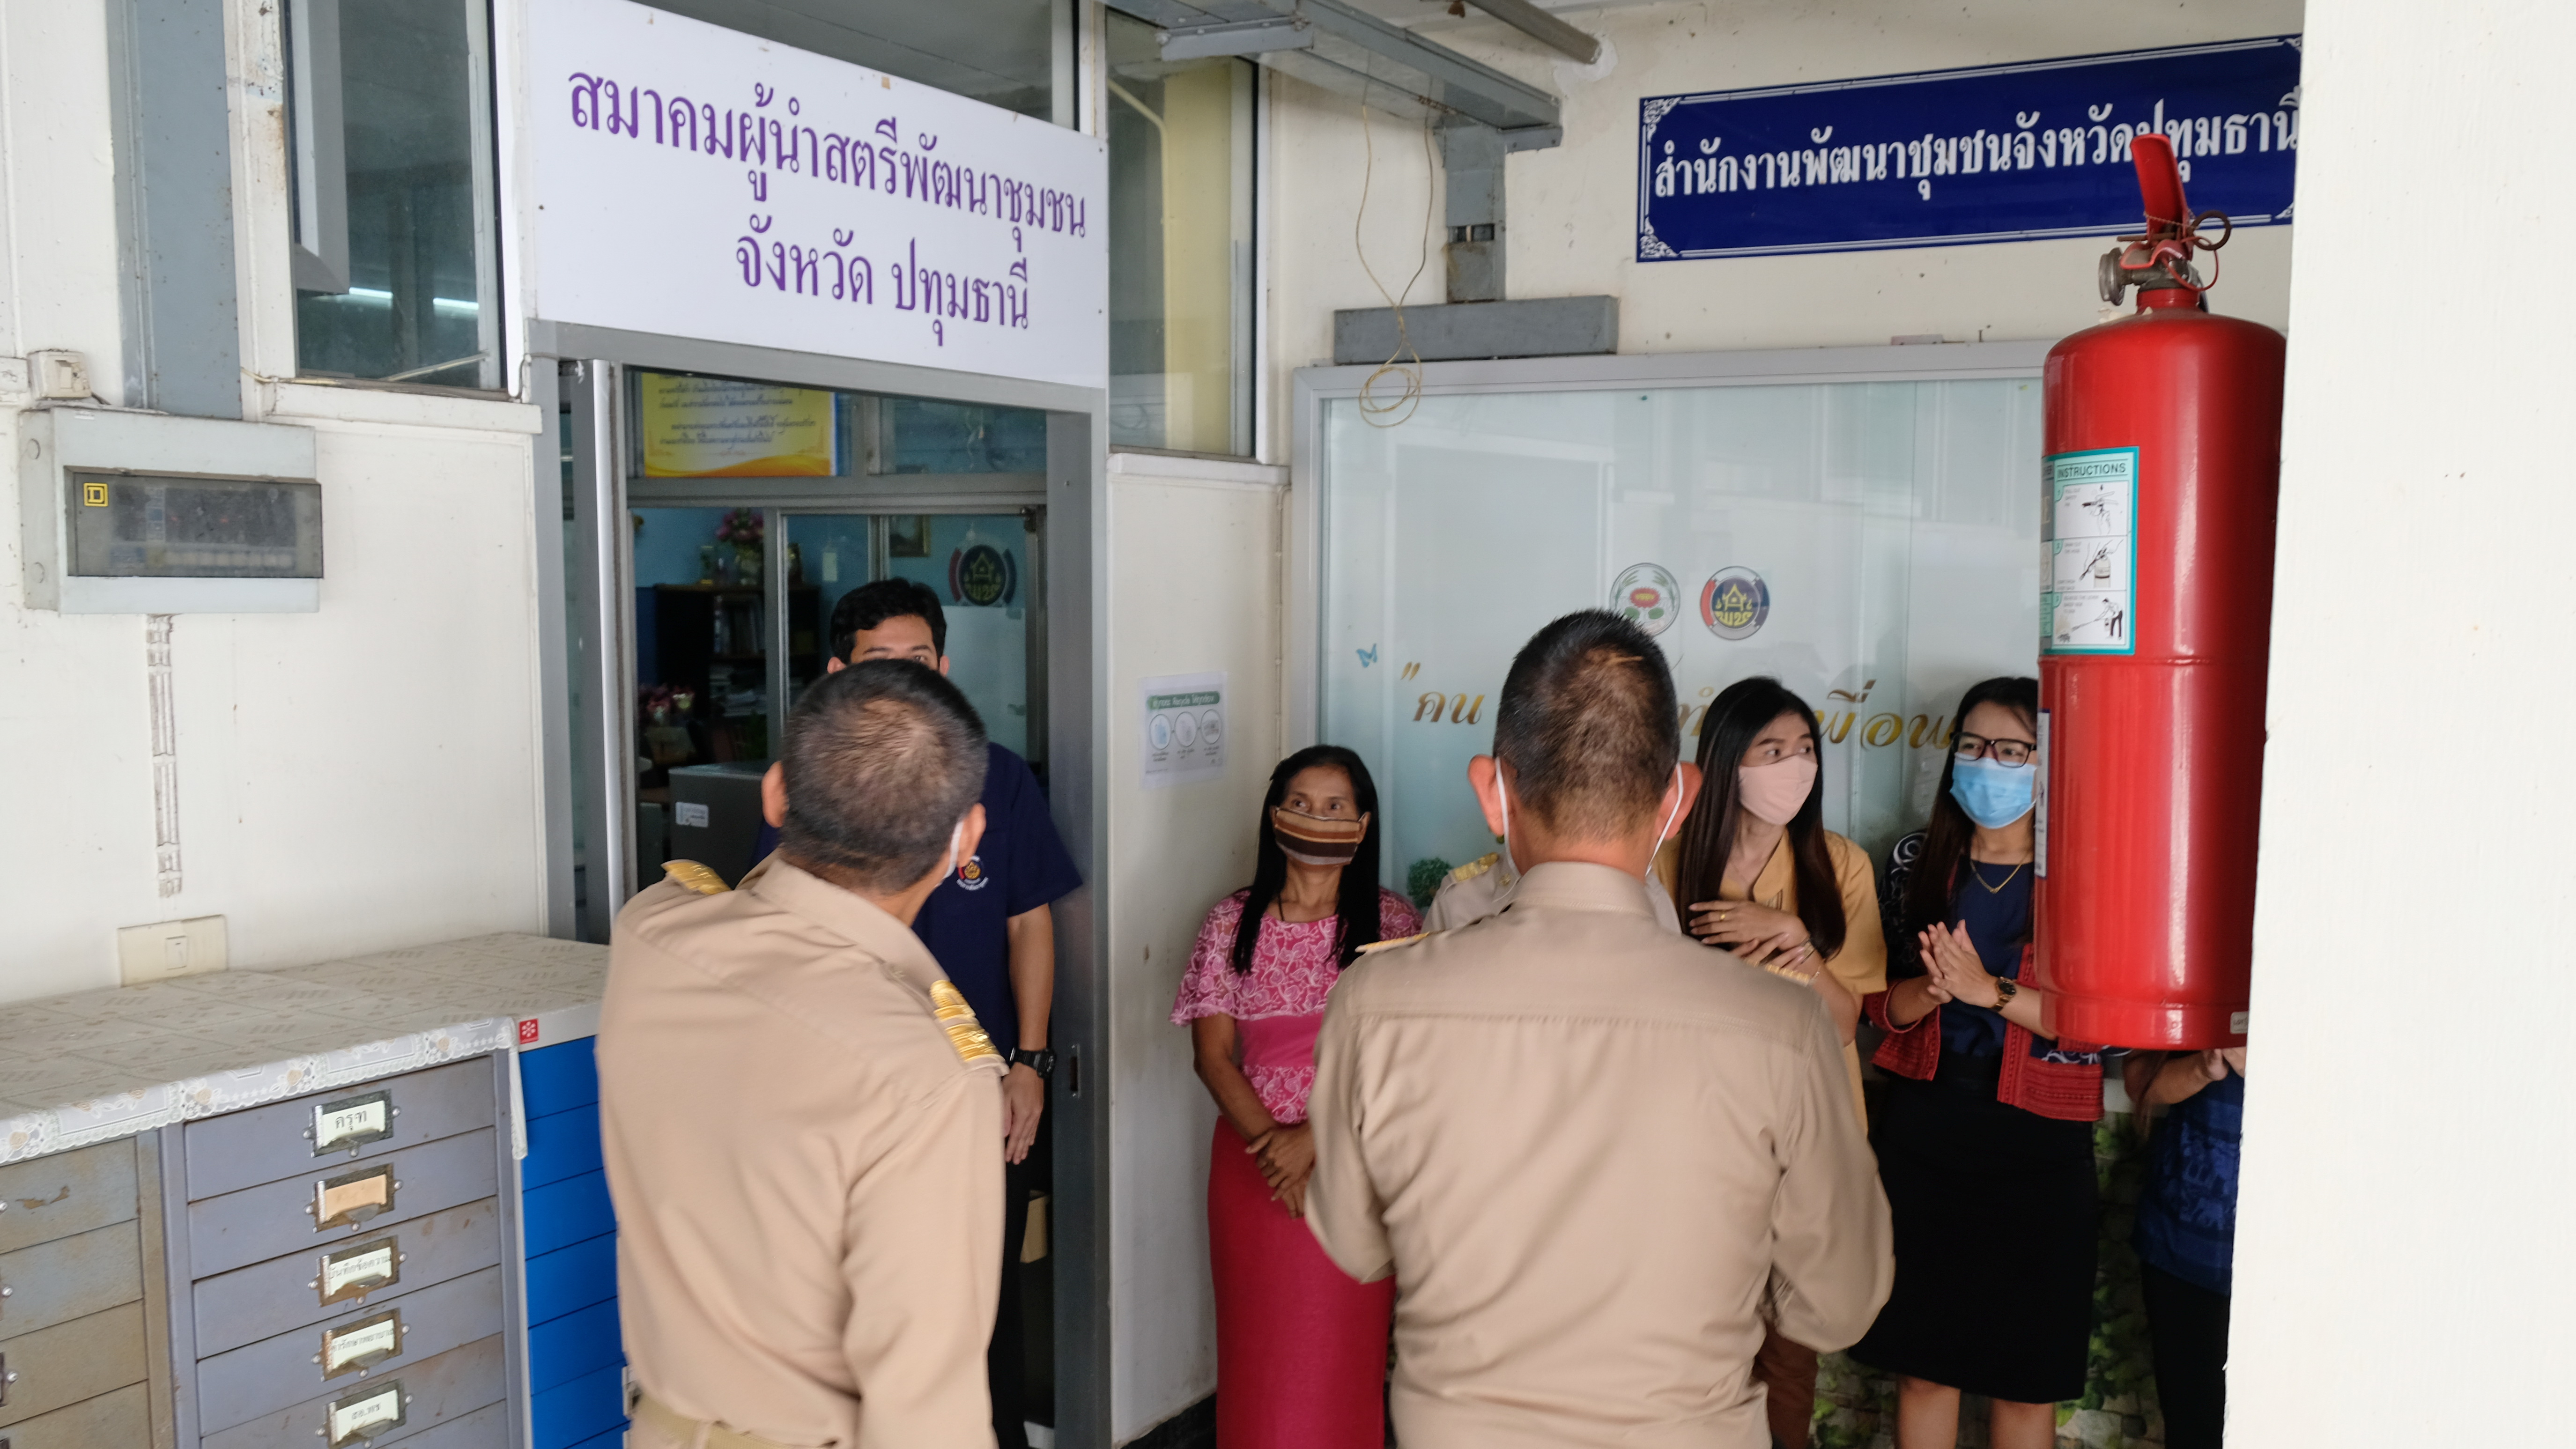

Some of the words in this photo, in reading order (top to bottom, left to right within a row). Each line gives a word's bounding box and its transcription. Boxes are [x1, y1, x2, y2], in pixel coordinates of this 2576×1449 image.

[568, 71, 1086, 253] สมาคมผู้นำสตรีพัฒนาชุมชน
[736, 213, 873, 305] จังหวัด
[891, 237, 1029, 347] ปทุมธานี
[2057, 462, 2126, 479] INSTRUCTIONS
